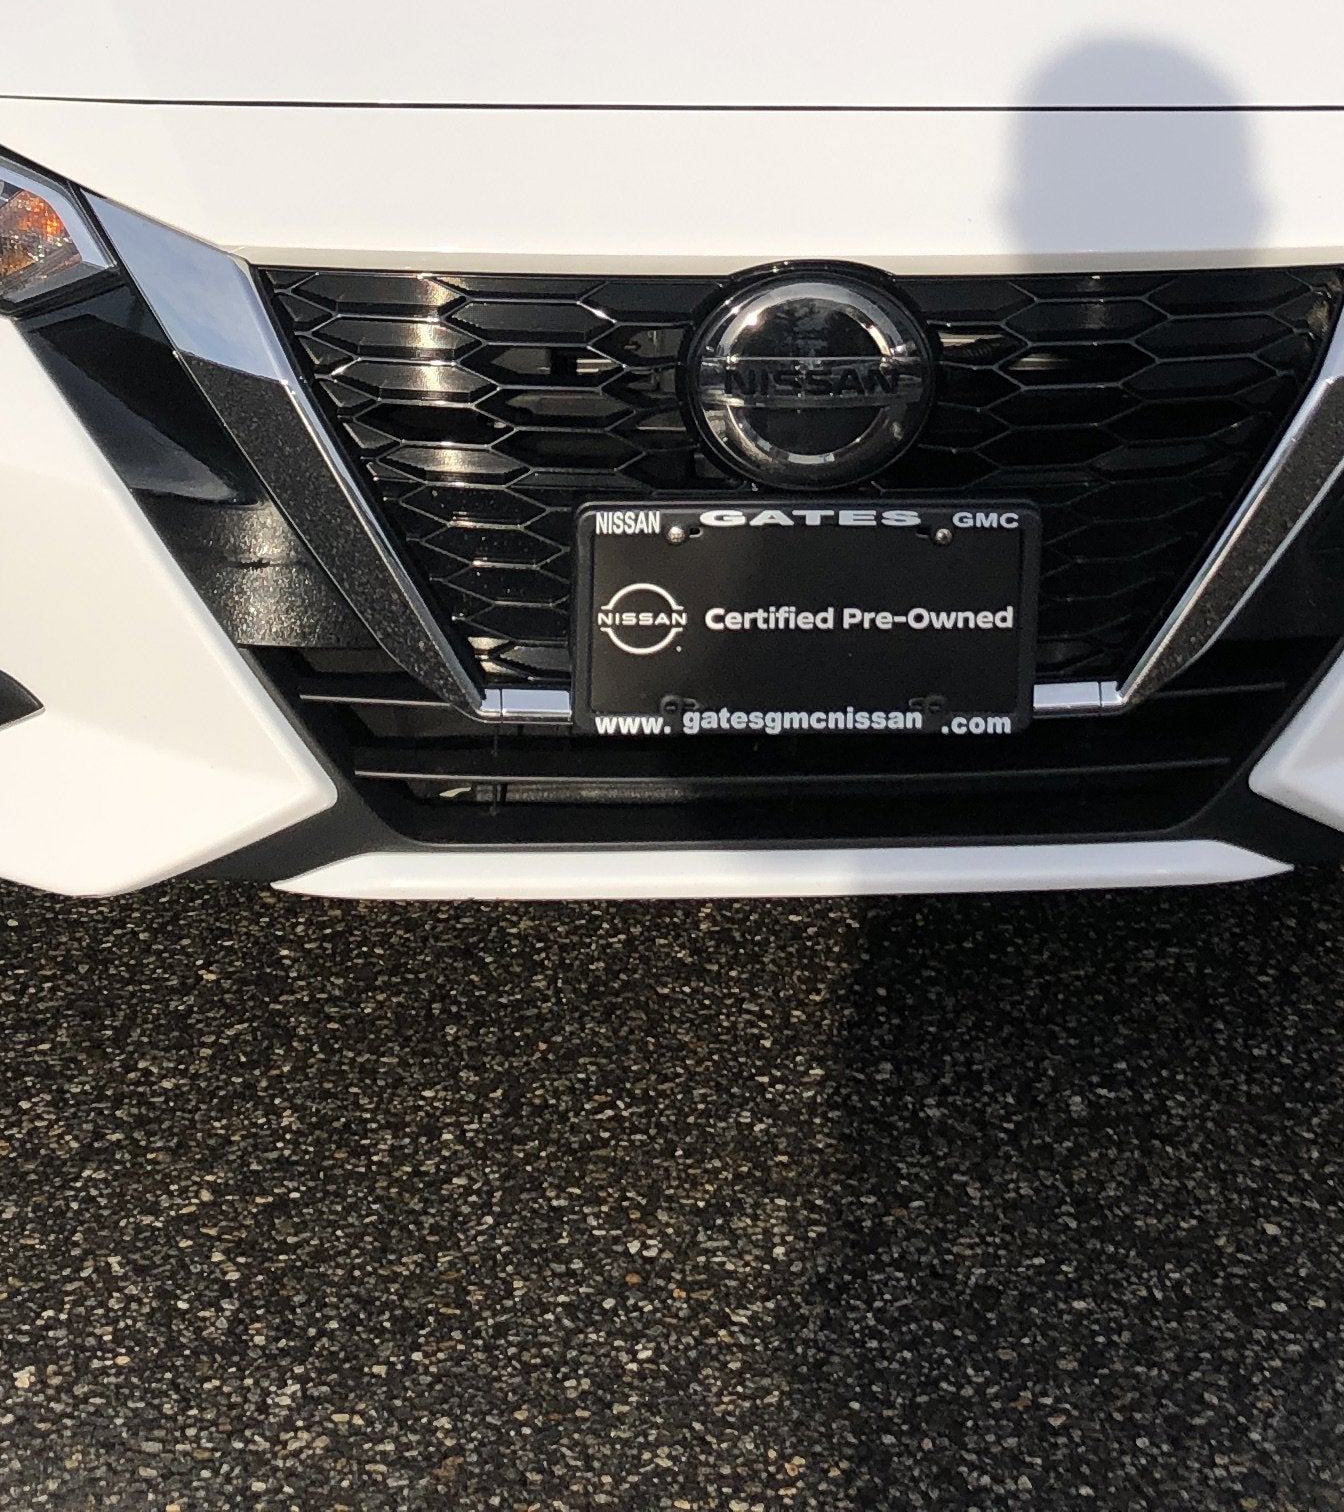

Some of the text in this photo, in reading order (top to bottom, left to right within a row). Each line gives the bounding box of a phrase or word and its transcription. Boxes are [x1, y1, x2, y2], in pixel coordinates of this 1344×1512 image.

[725, 369, 900, 395] NISSAN
[595, 509, 1020, 535] NISSAN GATES GMC
[598, 612, 687, 626] NISSAN
[705, 606, 1014, 630] Certified Pre-Owned
[682, 707, 923, 735] gatesgmcnissan
